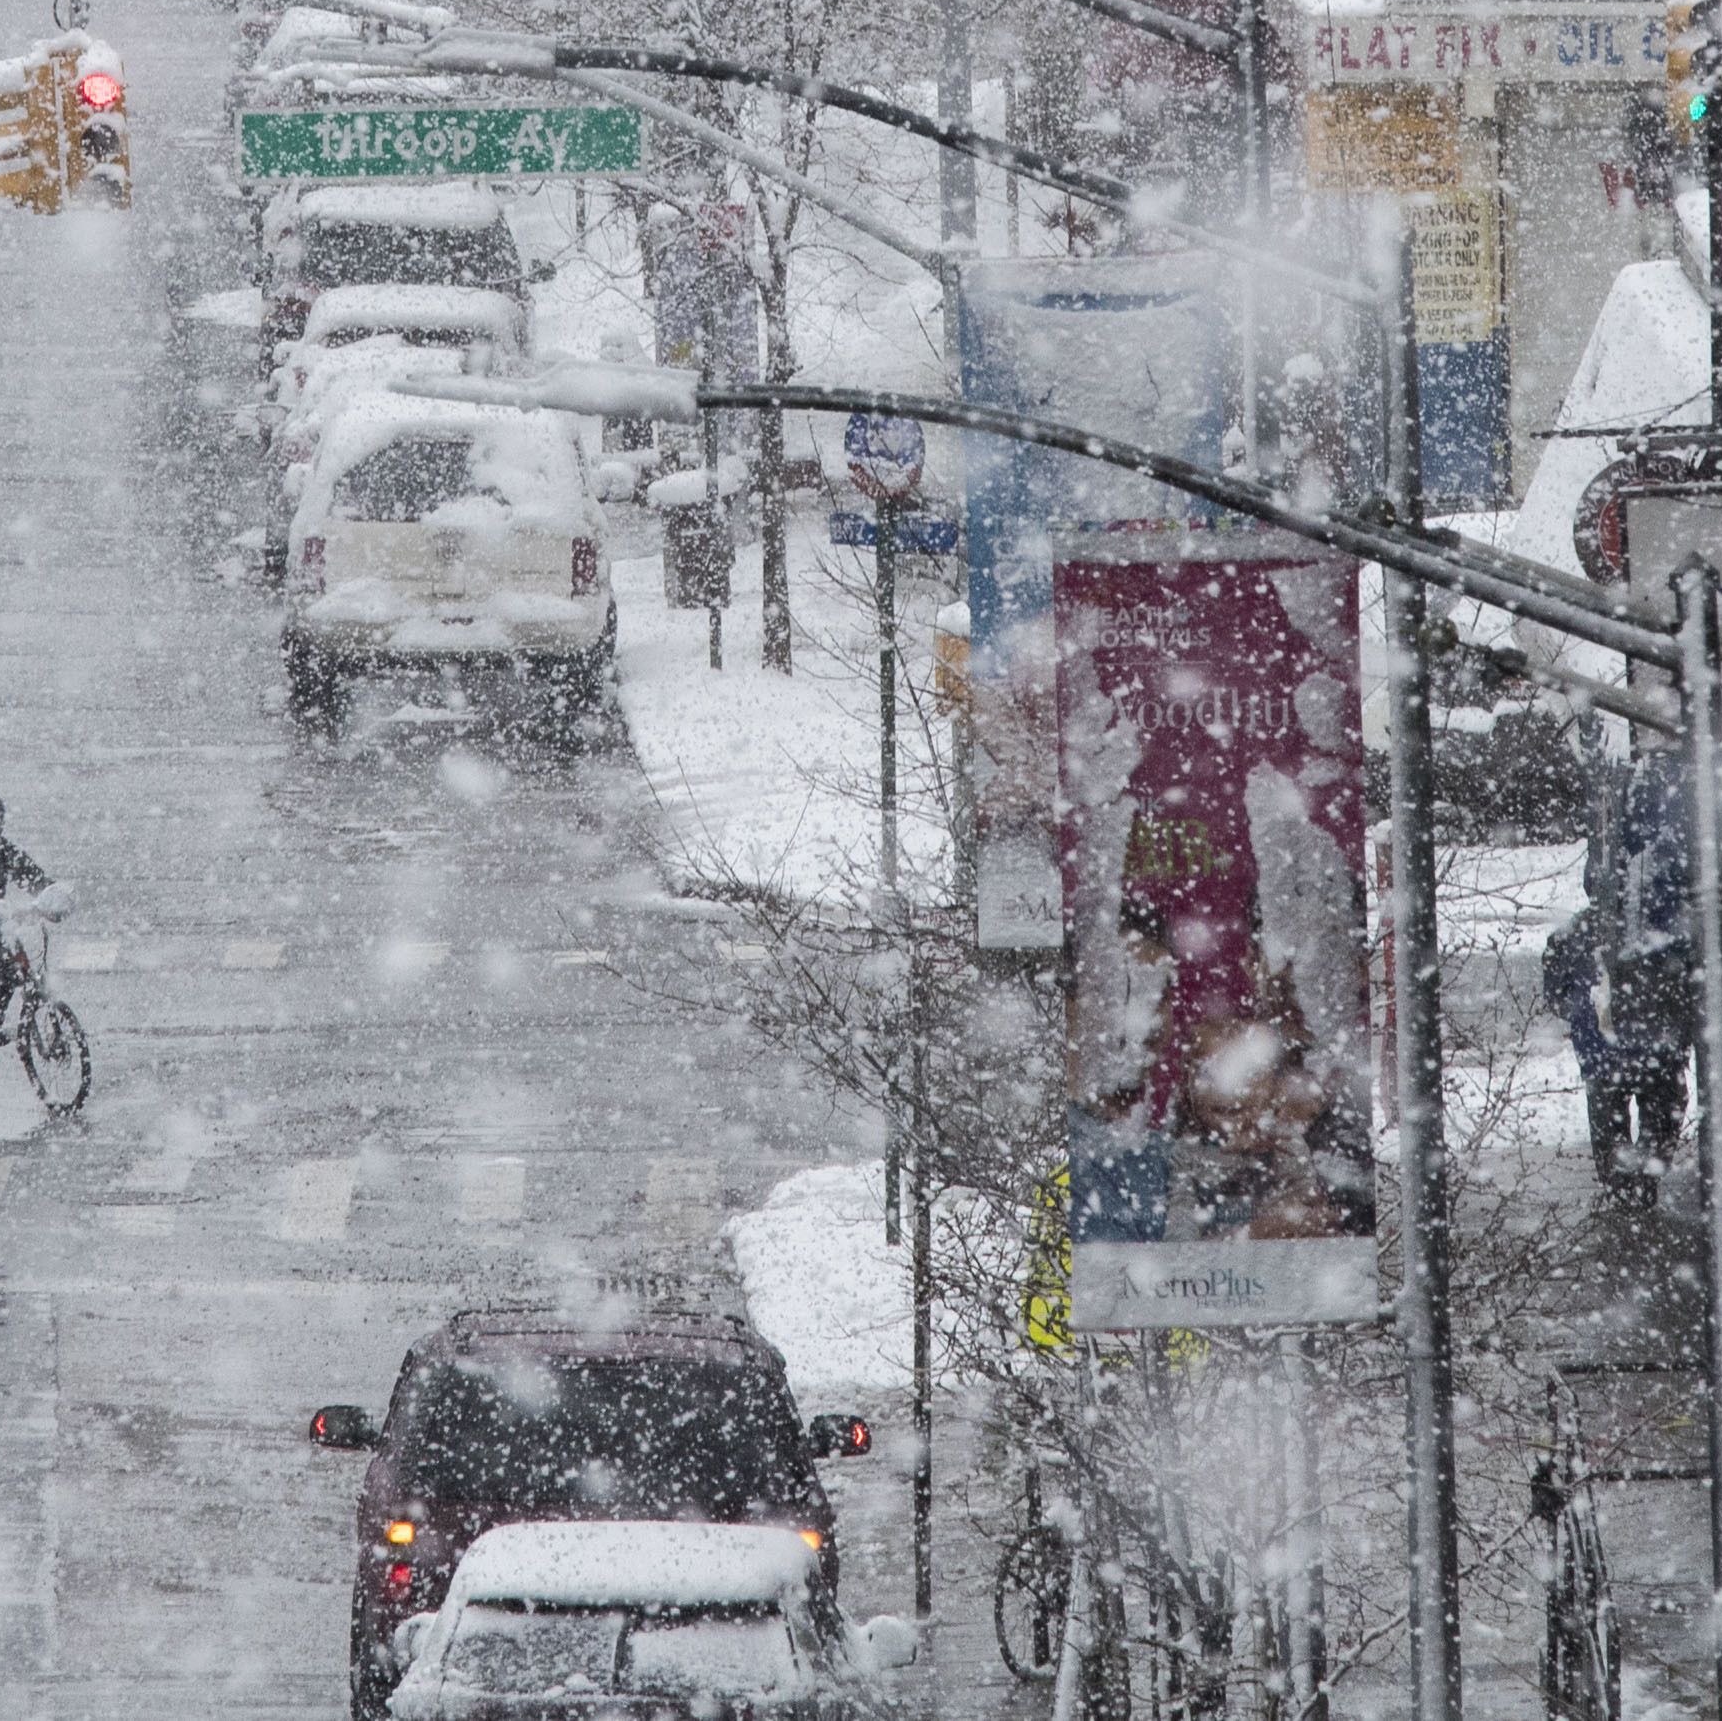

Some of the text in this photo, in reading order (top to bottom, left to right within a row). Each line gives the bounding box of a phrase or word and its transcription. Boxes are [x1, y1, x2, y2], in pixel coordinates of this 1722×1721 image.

[1314, 25, 1417, 70] FLAT
[1436, 24, 1502, 69] FIX
[1557, 22, 1625, 67] OIL
[315, 119, 478, 165] Throop
[1097, 606, 1174, 627] EALTH
[1097, 627, 1213, 649] OSPITALS
